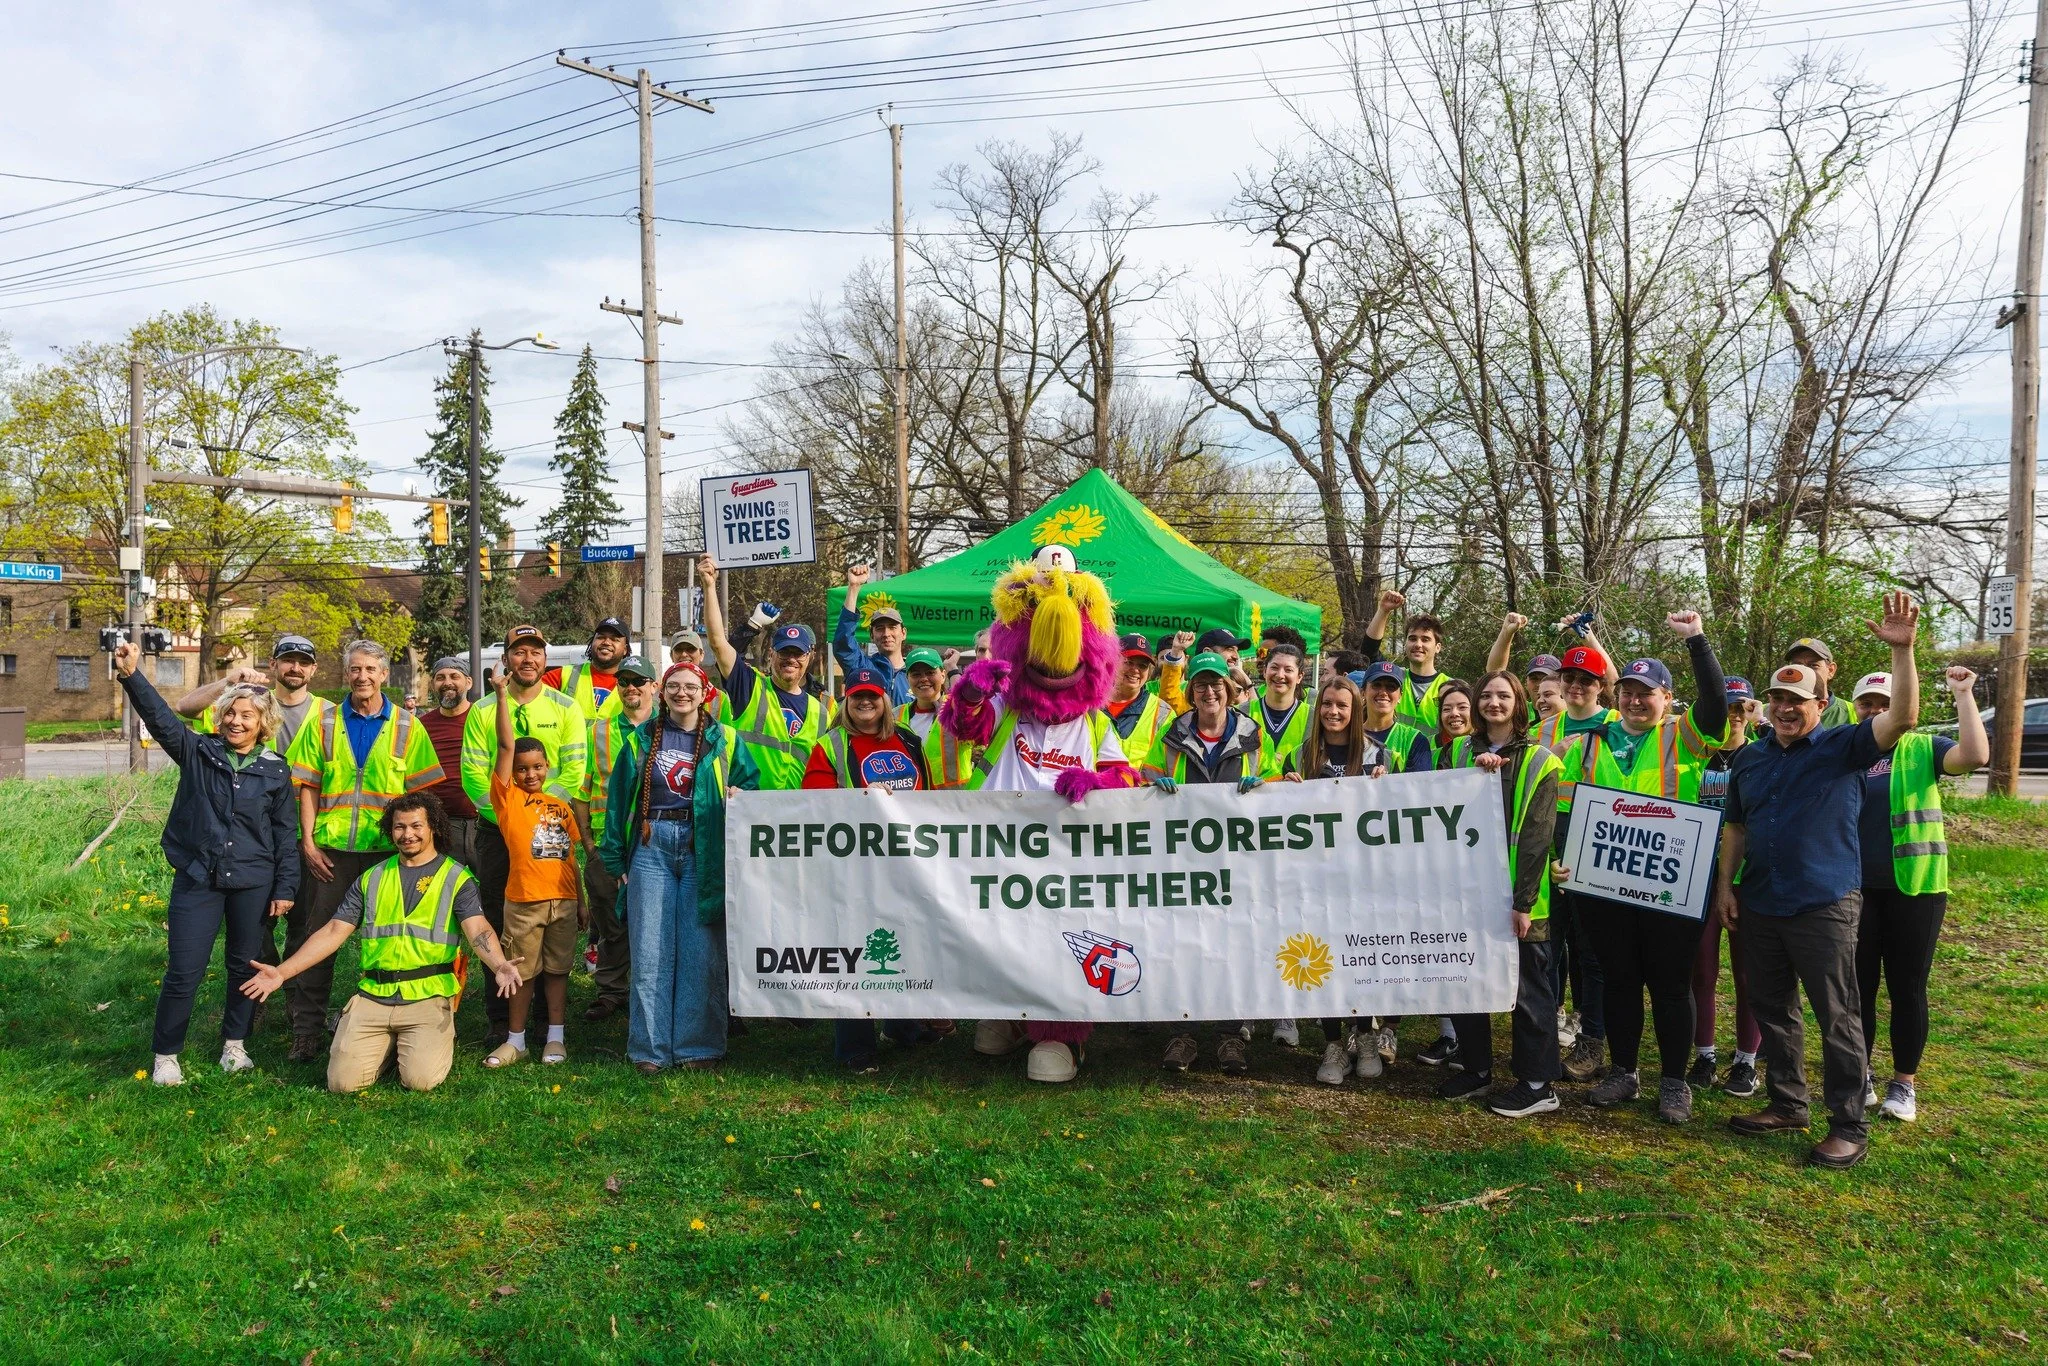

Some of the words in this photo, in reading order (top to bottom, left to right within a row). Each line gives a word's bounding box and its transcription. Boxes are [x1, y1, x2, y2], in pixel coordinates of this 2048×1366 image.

[731, 478, 777, 497] Guardians
[723, 501, 775, 520] SWING
[724, 518, 791, 544] TREES
[588, 548, 629, 559] Buckeye
[751, 552, 781, 561] DAVEY
[26, 565, 55, 579] King
[1993, 582, 2014, 592] SPEED
[1994, 594, 2011, 604] LIMIT
[911, 605, 974, 620] Western
[1991, 606, 2013, 628] 35
[1115, 613, 1203, 633] nservancy
[1574, 650, 1586, 664] C
[860, 672, 870, 681] C
[869, 755, 906, 774] CLE
[1612, 798, 1677, 818] Guardians
[750, 823, 1049, 858] REFORESTING
[1062, 821, 1152, 857] THE
[1165, 813, 1342, 854] FOREST
[1356, 805, 1480, 848] CITY,
[1594, 821, 1666, 852] SWING
[1671, 837, 1686, 847] FOR
[1669, 846, 1684, 856] THE
[1592, 841, 1681, 884] TREES
[970, 868, 1233, 909] TOGETHER!
[1588, 882, 1611, 891] Presented
[1618, 886, 1659, 903] DAVEY
[1345, 933, 1405, 947] Western
[1410, 930, 1468, 945] Reserve
[756, 947, 864, 974] DAVEY
[1341, 953, 1377, 967] Land
[1381, 950, 1475, 966] Conservancy
[758, 979, 788, 991] Proven
[789, 979, 834, 992] Solutions
[834, 979, 850, 994] for
[851, 983, 859, 991] a
[861, 979, 904, 994] Growing
[905, 979, 933, 991] World
[1354, 977, 1372, 985] land
[1383, 976, 1411, 986] people
[1422, 974, 1468, 983] community
